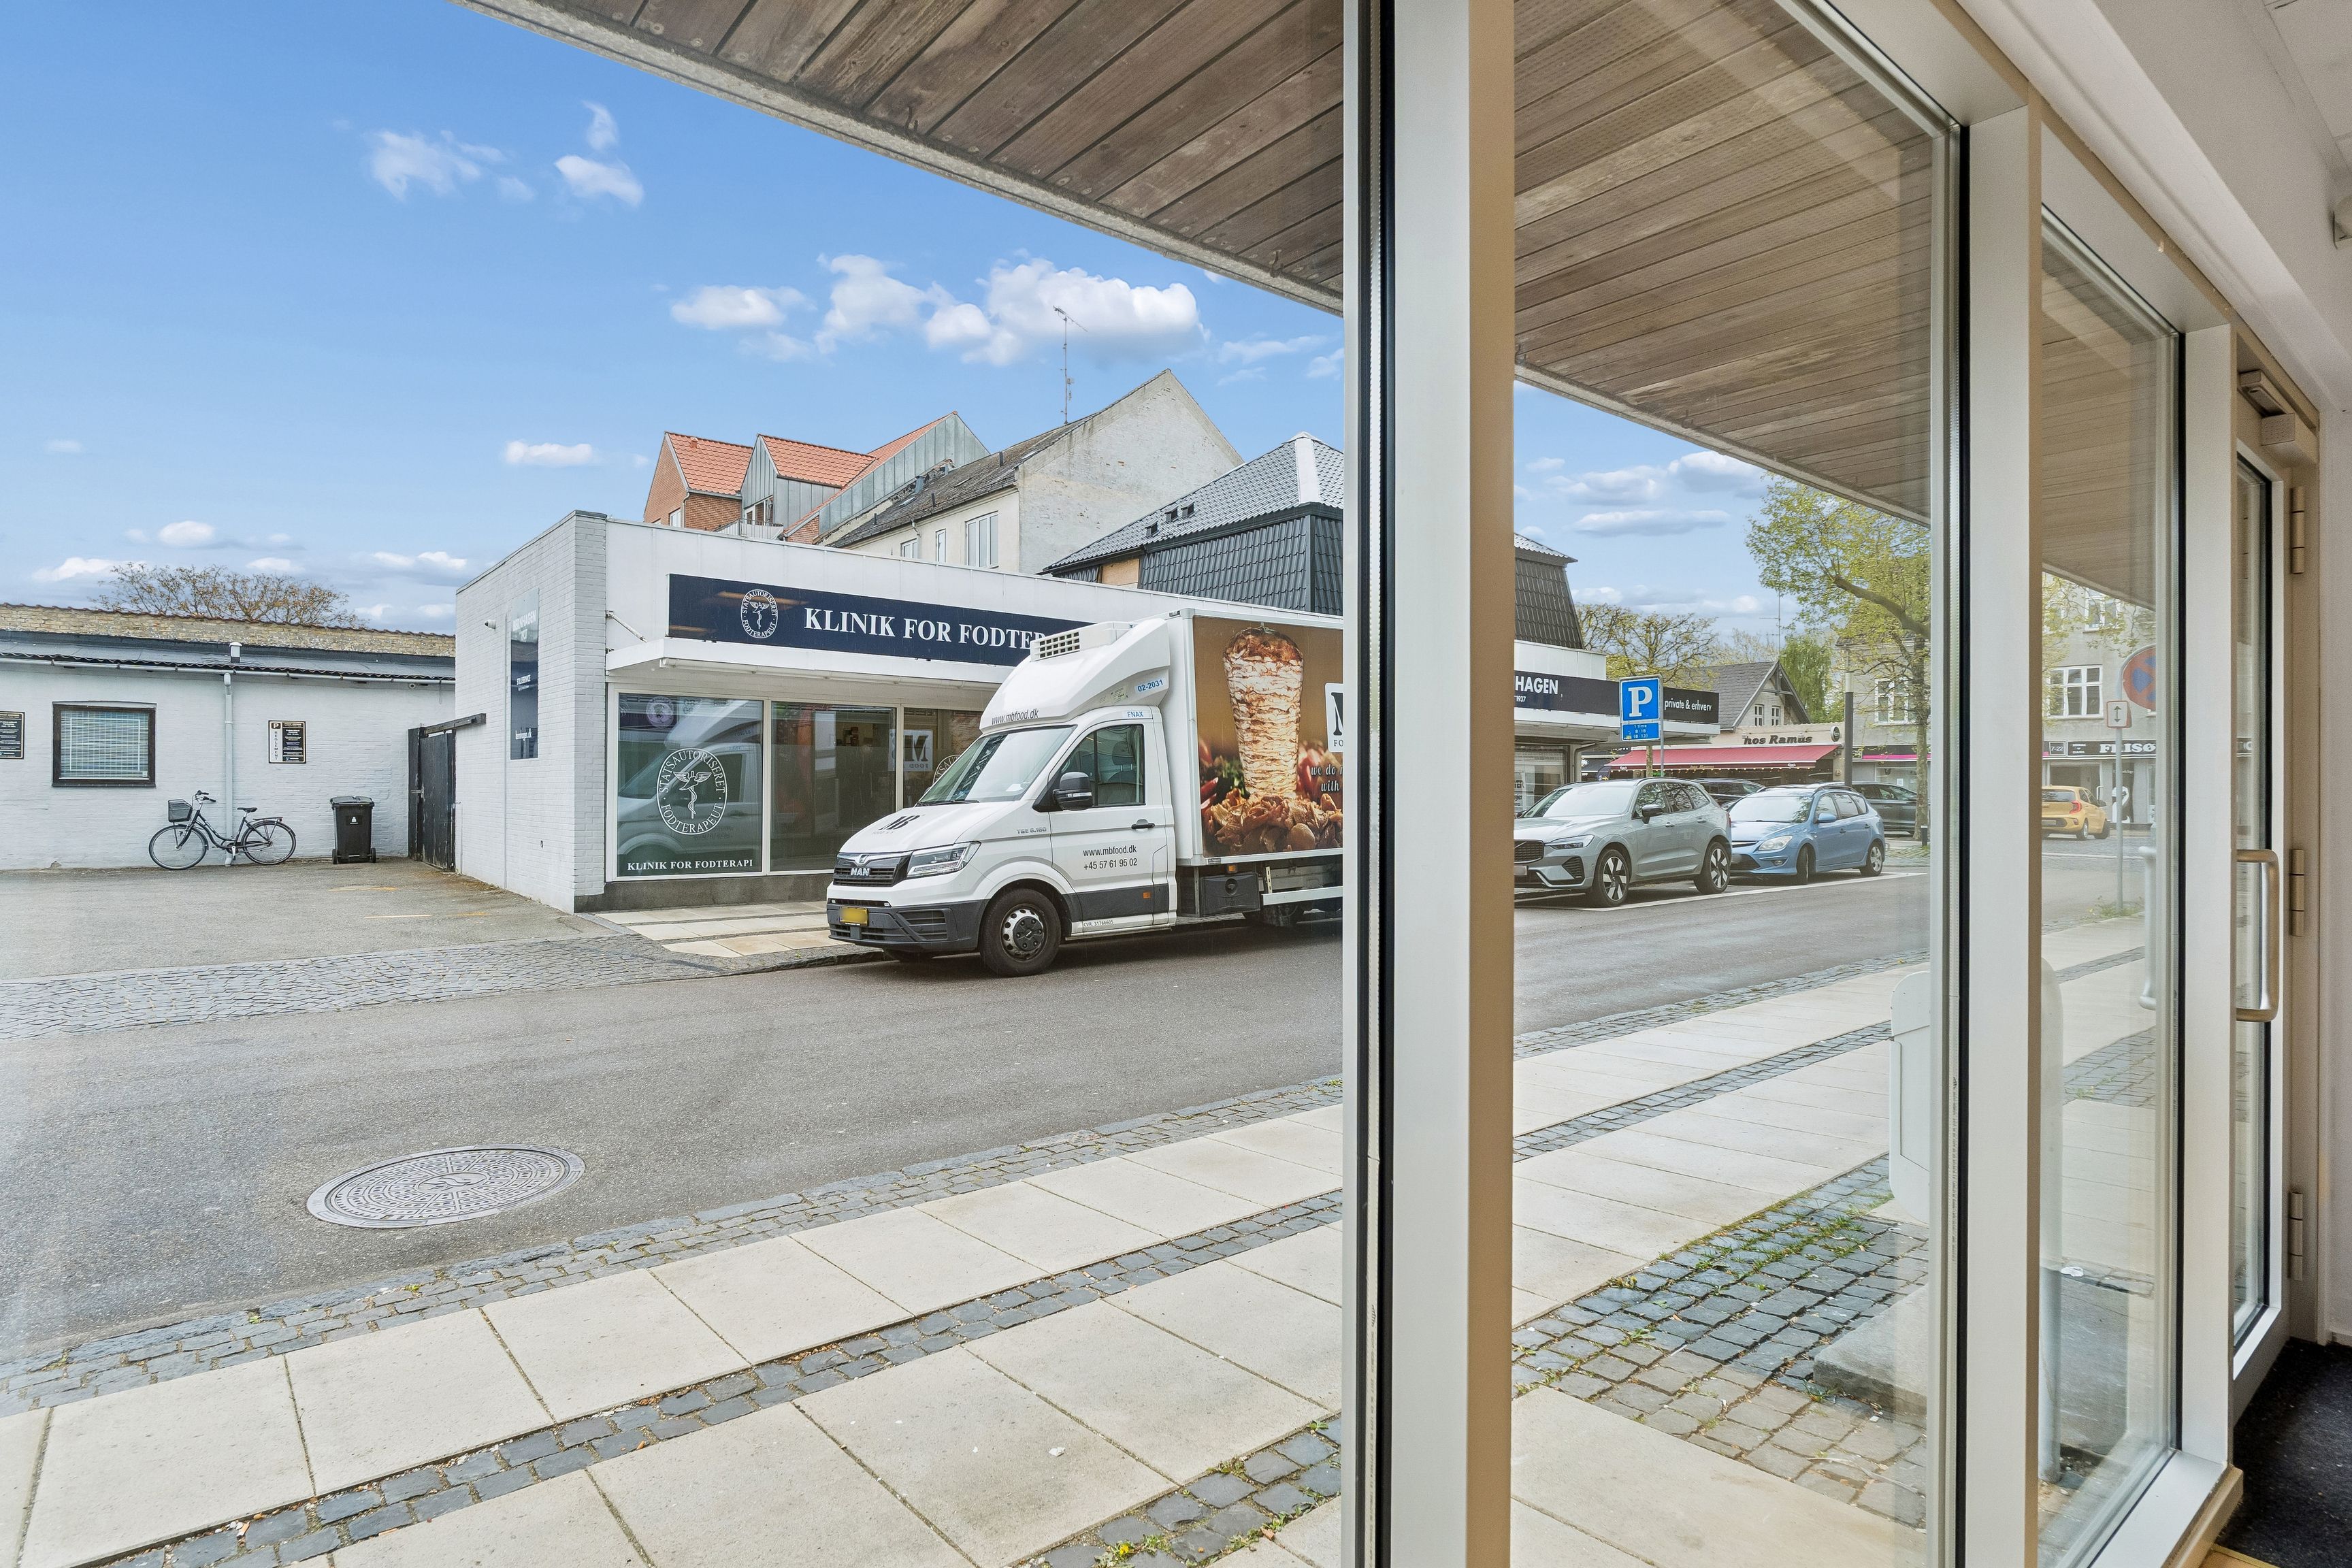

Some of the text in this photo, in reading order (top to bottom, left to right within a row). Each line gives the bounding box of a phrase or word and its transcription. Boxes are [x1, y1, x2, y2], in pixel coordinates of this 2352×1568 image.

[742, 590, 777, 619] STATSAUTORISERET
[743, 619, 775, 638] FODTERAPEUT
[804, 607, 896, 637] KLINIK
[903, 618, 952, 642] FOR
[1137, 679, 1163, 692] 02-2031
[1515, 675, 1558, 695] HAGEN
[1628, 686, 1652, 717] P
[1664, 700, 1712, 712] private & erhverv
[992, 708, 1040, 725] www.mbfood.dk
[1769, 735, 1813, 745] Ramus
[659, 750, 725, 794] STATSAUTORISERET
[1326, 764, 1336, 775] do
[1320, 780, 1340, 791] with
[661, 803, 723, 833] FODTERAPEUT
[1083, 845, 1137, 857] www.mbfood.dk
[627, 860, 753, 870] KLINIK FOR FODTERAPI
[1084, 858, 1137, 870] +45 57 61 95 02
[851, 868, 870, 877] MAN
